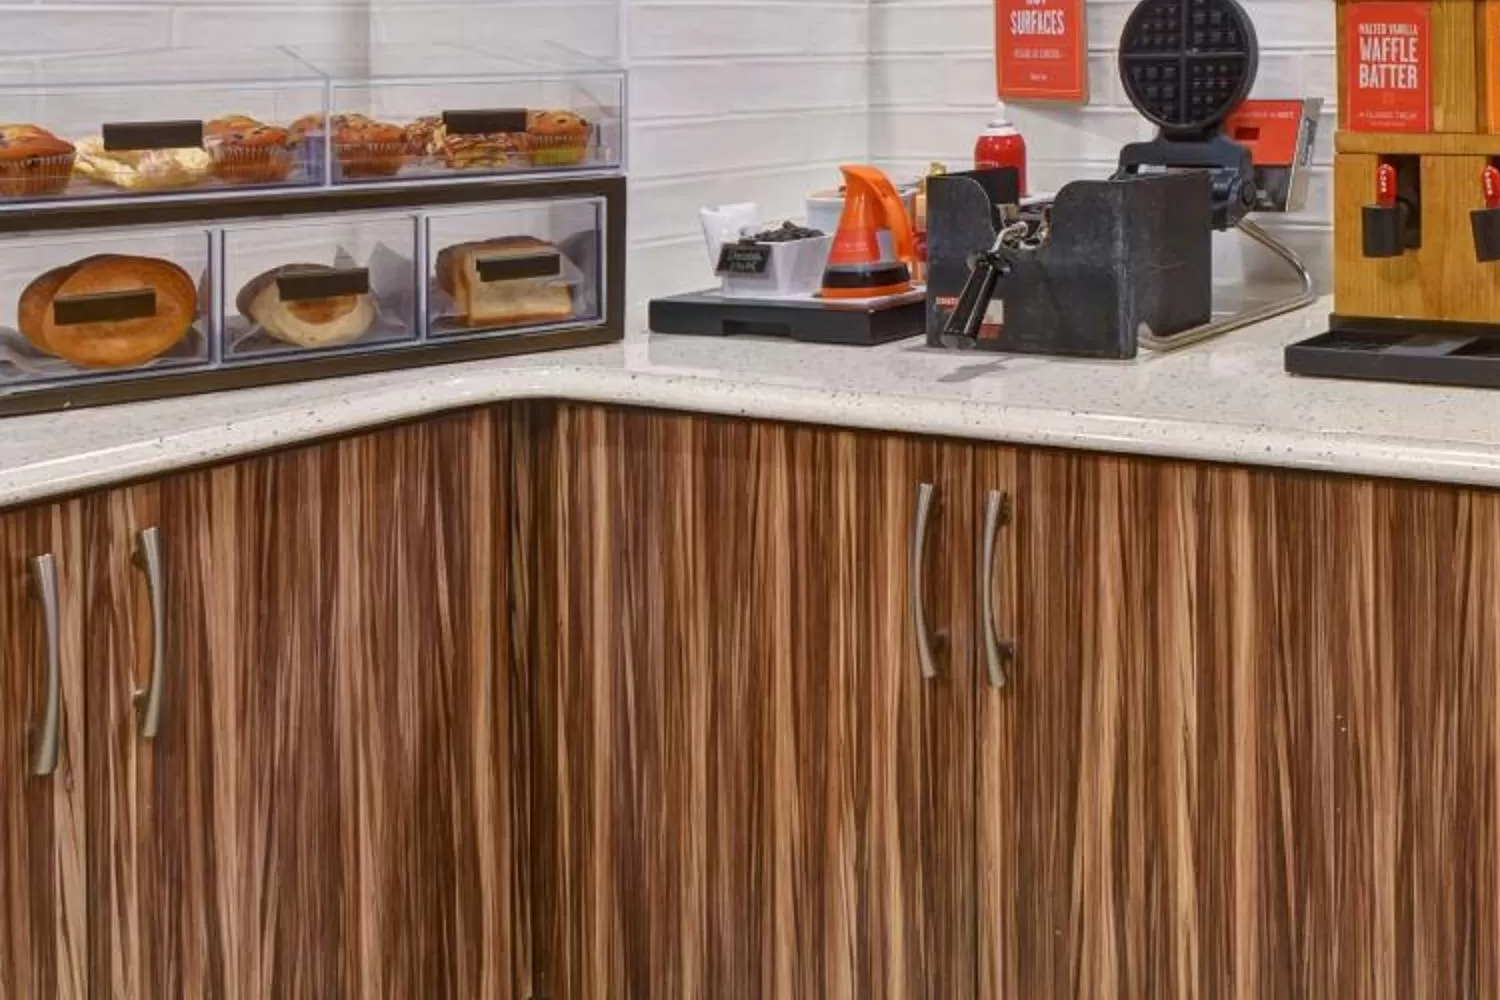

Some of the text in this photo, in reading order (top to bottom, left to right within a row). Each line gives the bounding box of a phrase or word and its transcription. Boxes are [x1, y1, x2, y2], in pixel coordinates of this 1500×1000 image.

[1010, 9, 1064, 35] SURFACES
[1359, 36, 1418, 63] WAFFLE
[1359, 63, 1418, 89] BATTER
